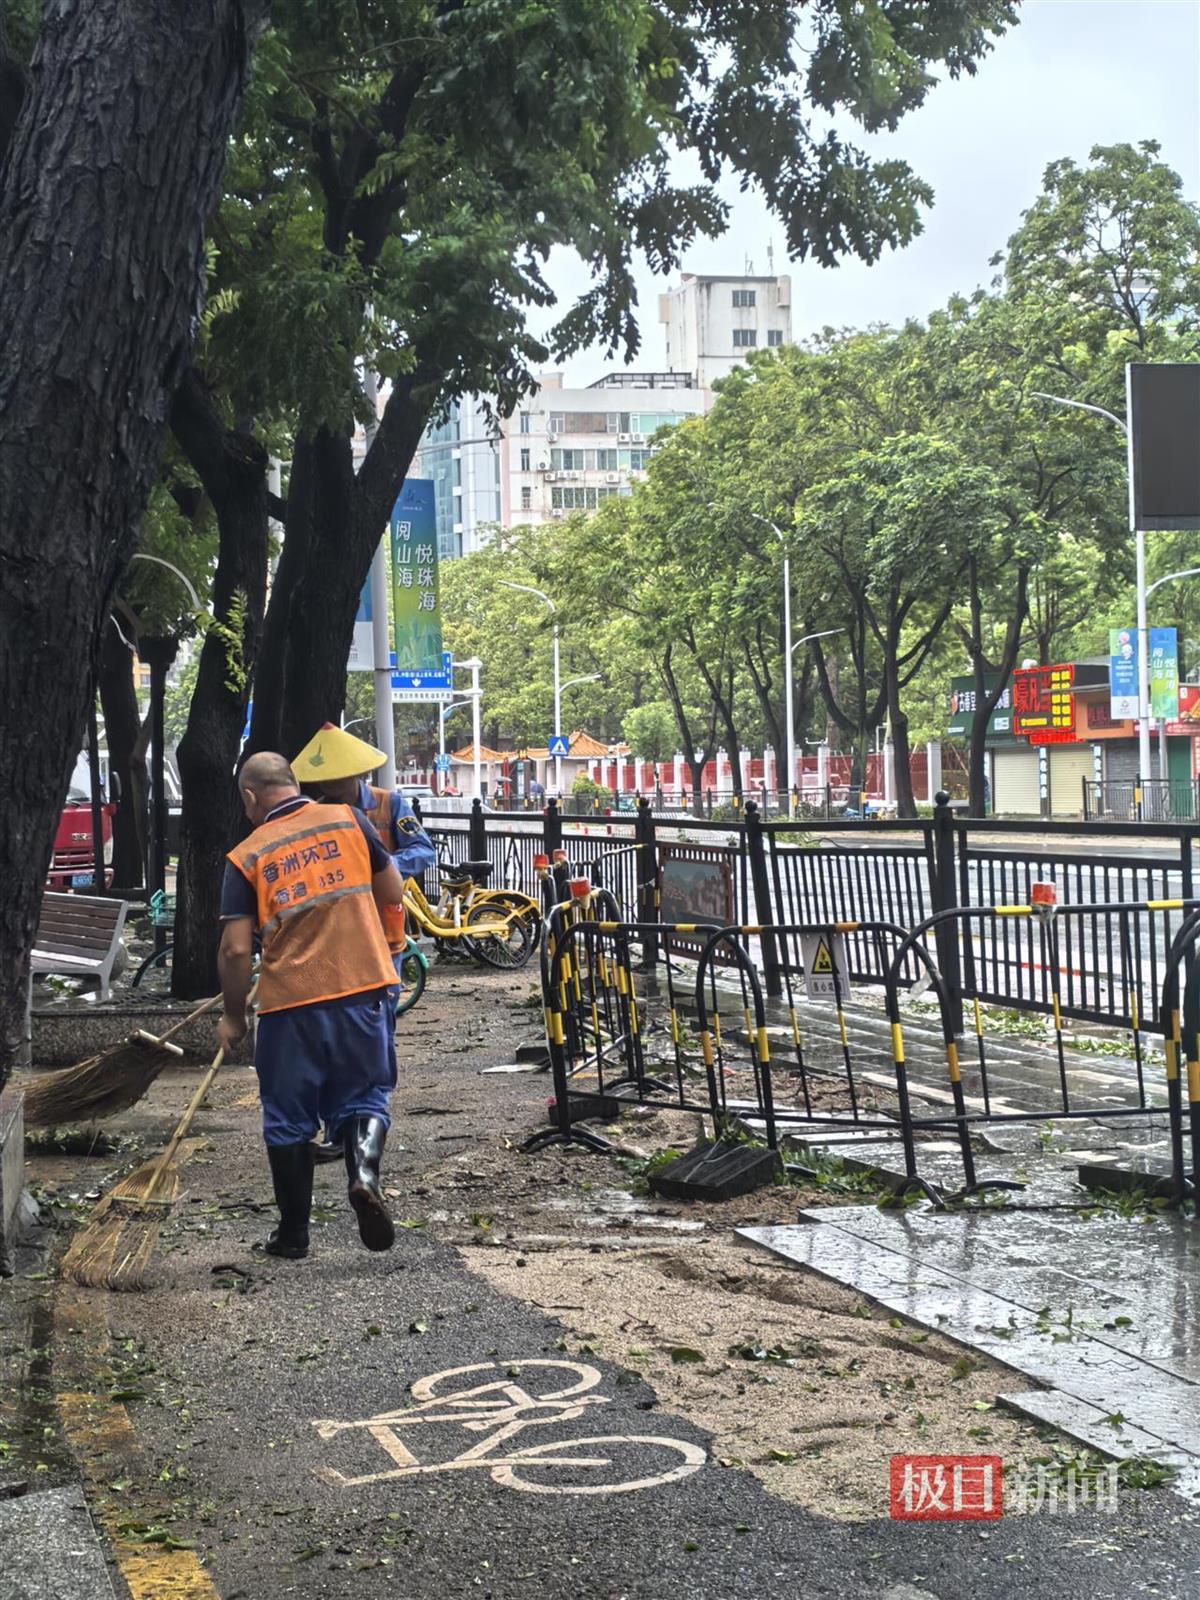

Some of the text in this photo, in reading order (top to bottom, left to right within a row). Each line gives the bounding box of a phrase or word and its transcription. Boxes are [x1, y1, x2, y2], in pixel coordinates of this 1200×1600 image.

[395, 519, 413, 588] 阅山海
[414, 543, 436, 611] 悦珠海
[262, 839, 342, 884] 香洲环卫
